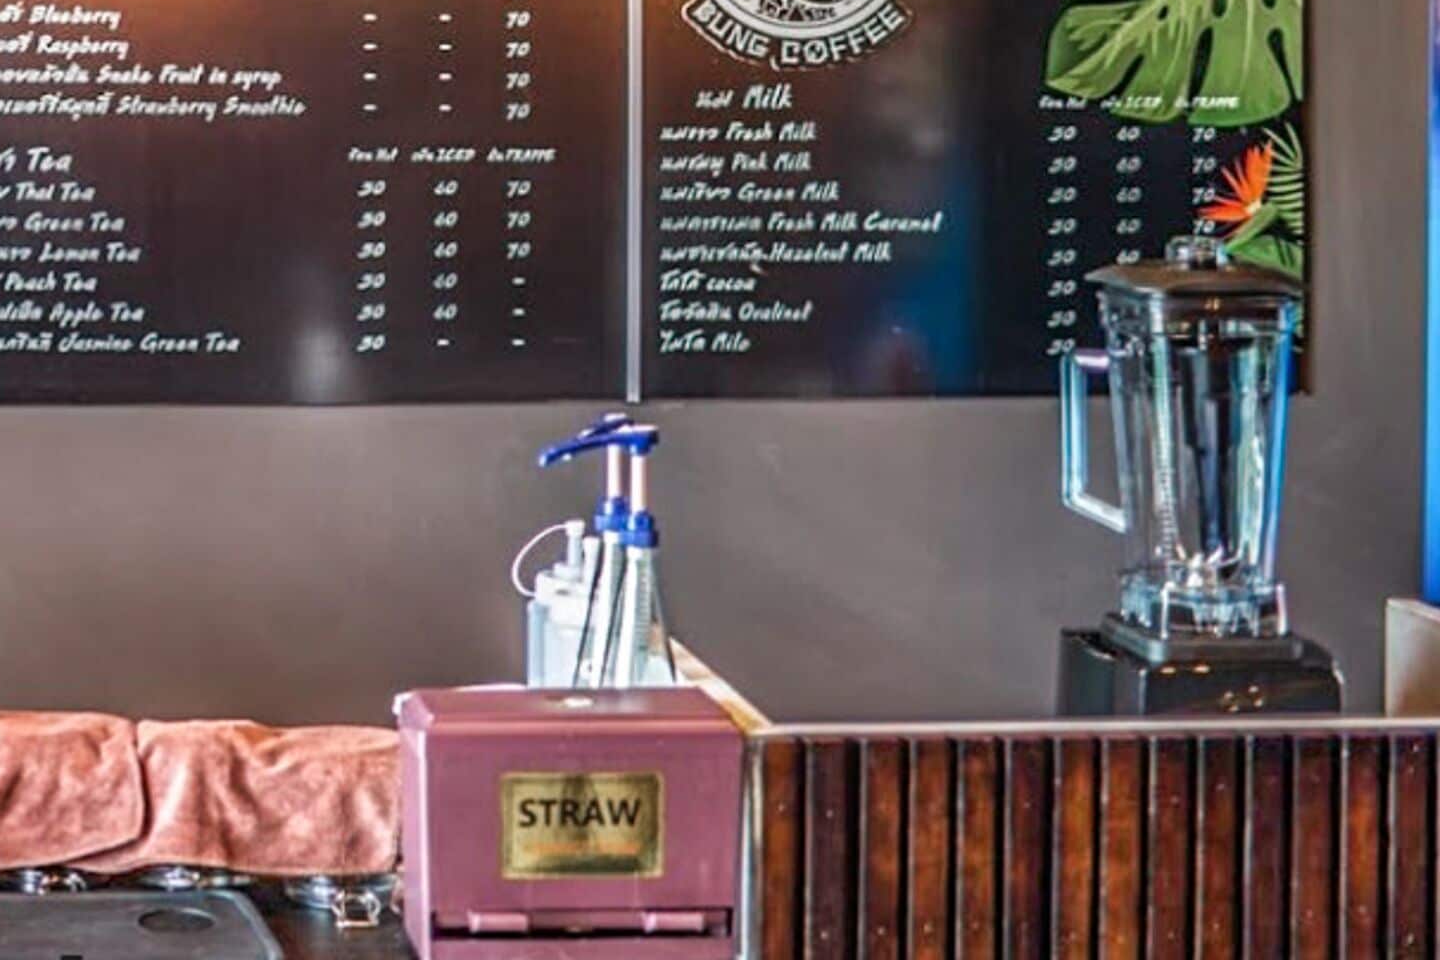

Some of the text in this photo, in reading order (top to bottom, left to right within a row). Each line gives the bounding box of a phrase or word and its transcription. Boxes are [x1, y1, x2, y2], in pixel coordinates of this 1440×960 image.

[29, 4, 121, 30] Blueberry
[507, 12, 530, 28] 70
[781, 2, 906, 64] COFFEE
[37, 35, 128, 60] Raspberry
[507, 42, 530, 58] 70
[507, 72, 530, 89] 70
[743, 83, 792, 109] Milk
[116, 95, 217, 122] Strawberry
[507, 104, 530, 120] 70
[725, 122, 772, 141] Fresh
[779, 122, 815, 141] Milk
[1193, 127, 1215, 142] 70
[28, 147, 72, 171] Tea
[773, 152, 810, 171] Milk
[1192, 157, 1216, 174] 70
[16, 182, 55, 200] Thai
[61, 182, 95, 201] Tea
[507, 181, 530, 198] 70
[738, 182, 795, 201] Green
[801, 181, 838, 200] Milk
[1192, 187, 1216, 204] 70
[24, 212, 83, 232] Green
[91, 212, 124, 231] Tea
[508, 212, 530, 228] 70
[767, 212, 814, 231] Fresh
[820, 212, 857, 231] Milk
[1193, 217, 1215, 234] 70
[38, 242, 99, 262] Lemon
[107, 242, 140, 261] Tea
[507, 242, 530, 259] 70
[853, 242, 890, 261] Milk
[64, 272, 97, 291] Tea
[111, 302, 144, 321] Tea
[140, 332, 198, 352] Green
[206, 332, 240, 351] Tea
[518, 798, 641, 828] STRAW
